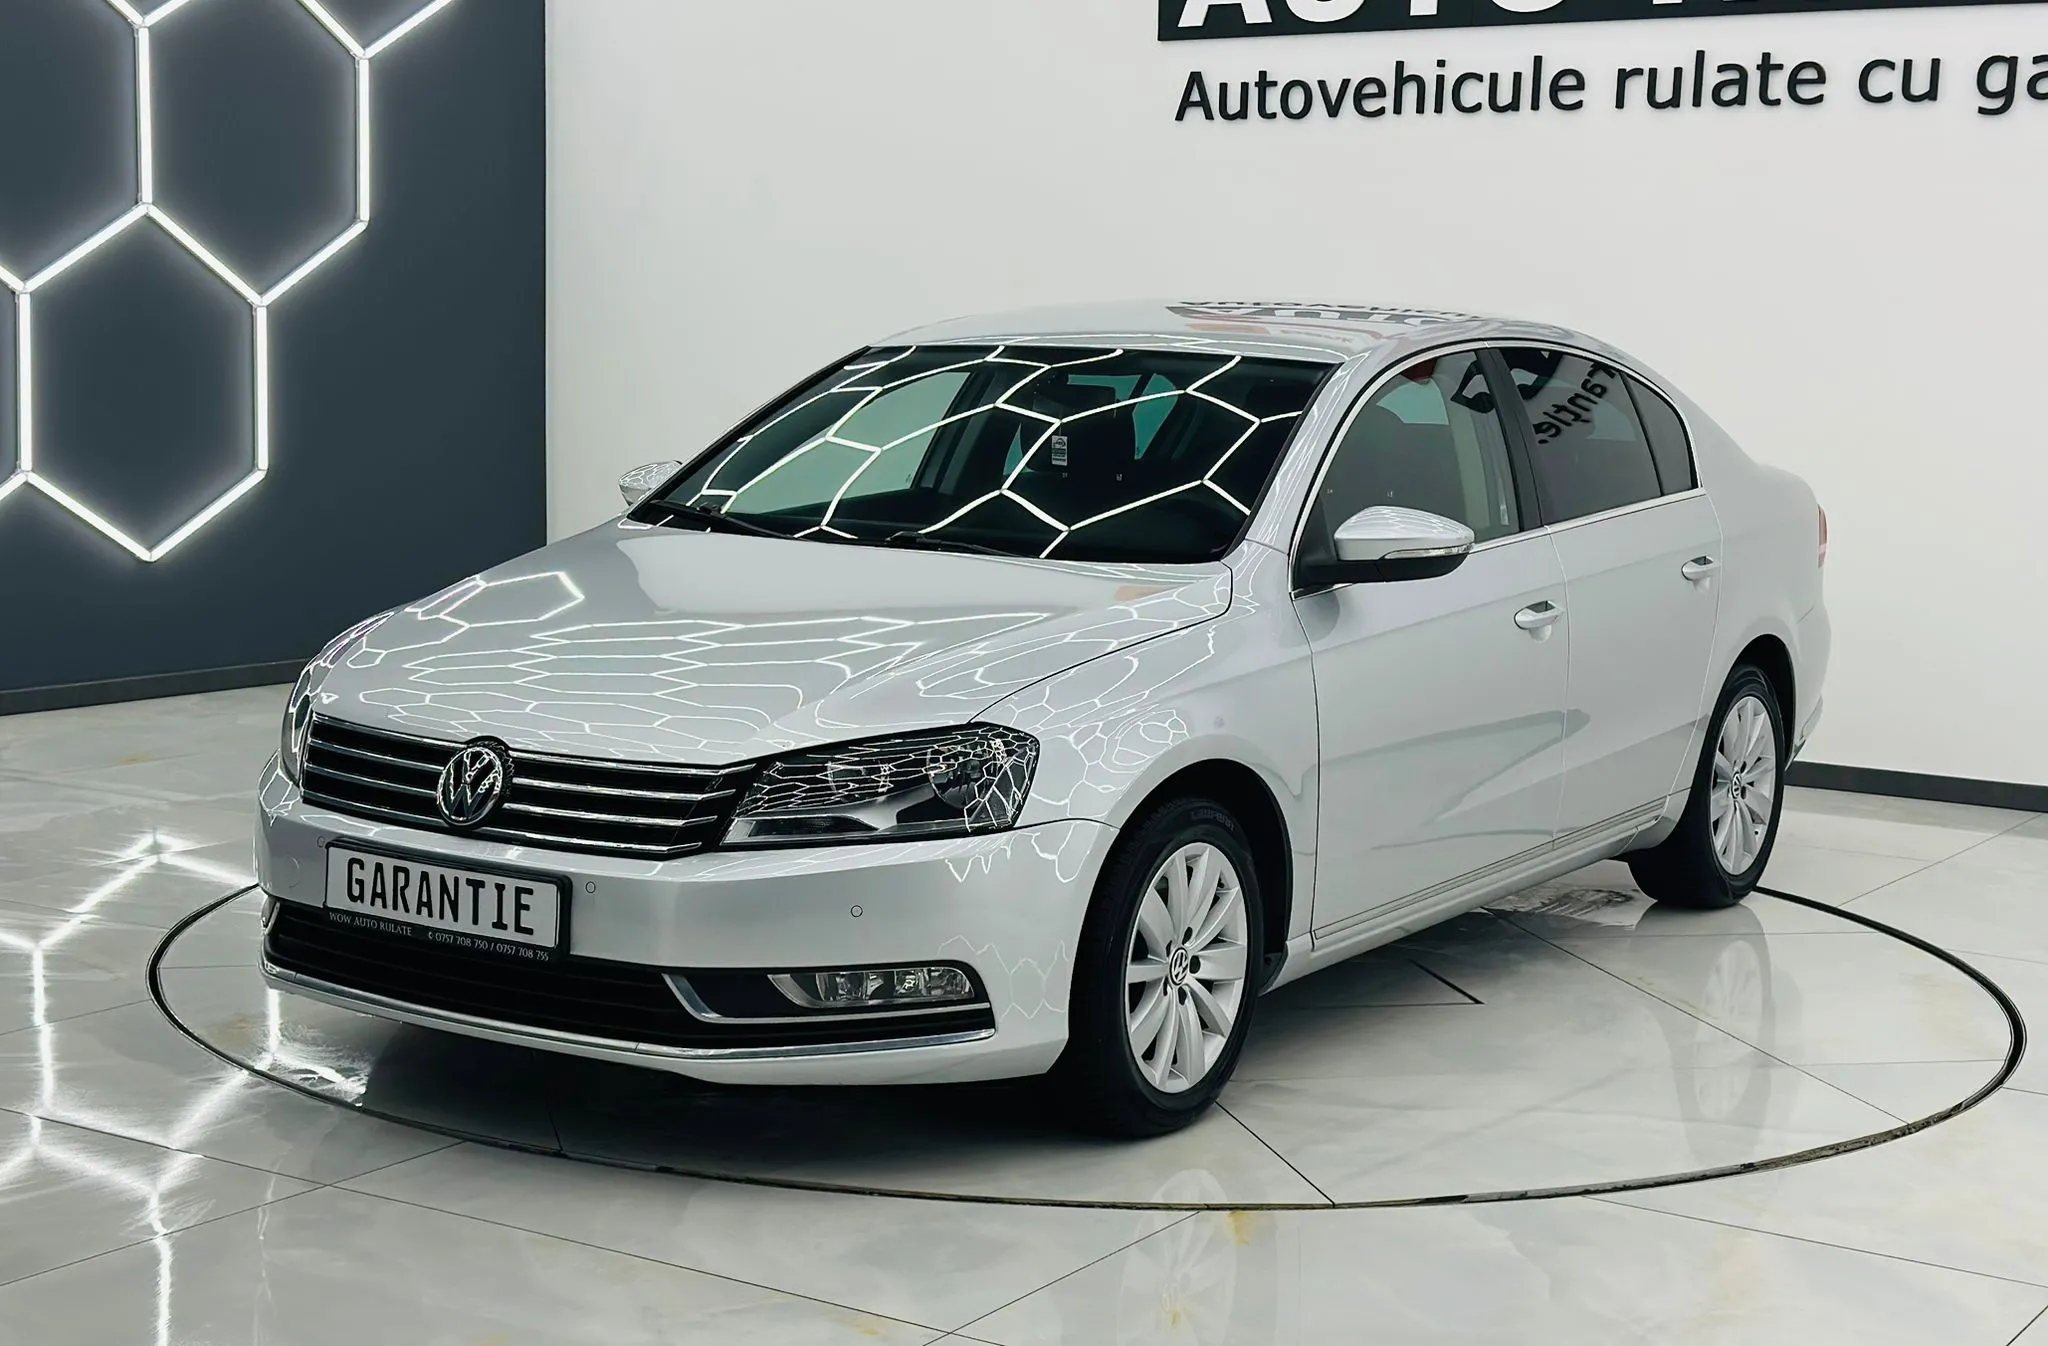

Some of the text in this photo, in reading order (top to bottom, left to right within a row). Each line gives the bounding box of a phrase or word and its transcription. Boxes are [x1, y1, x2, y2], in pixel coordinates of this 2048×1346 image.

[1174, 55, 1586, 122] Autovehicule
[1614, 49, 1828, 111] rulate
[1858, 57, 1943, 105] cu
[346, 857, 535, 937] GARANTIE
[329, 911, 412, 937] WOW AUTO RULATE
[435, 932, 454, 944] 0757
[455, 936, 472, 948] 708
[473, 939, 489, 951] 750
[496, 943, 516, 956] 0757
[518, 946, 534, 959] 708
